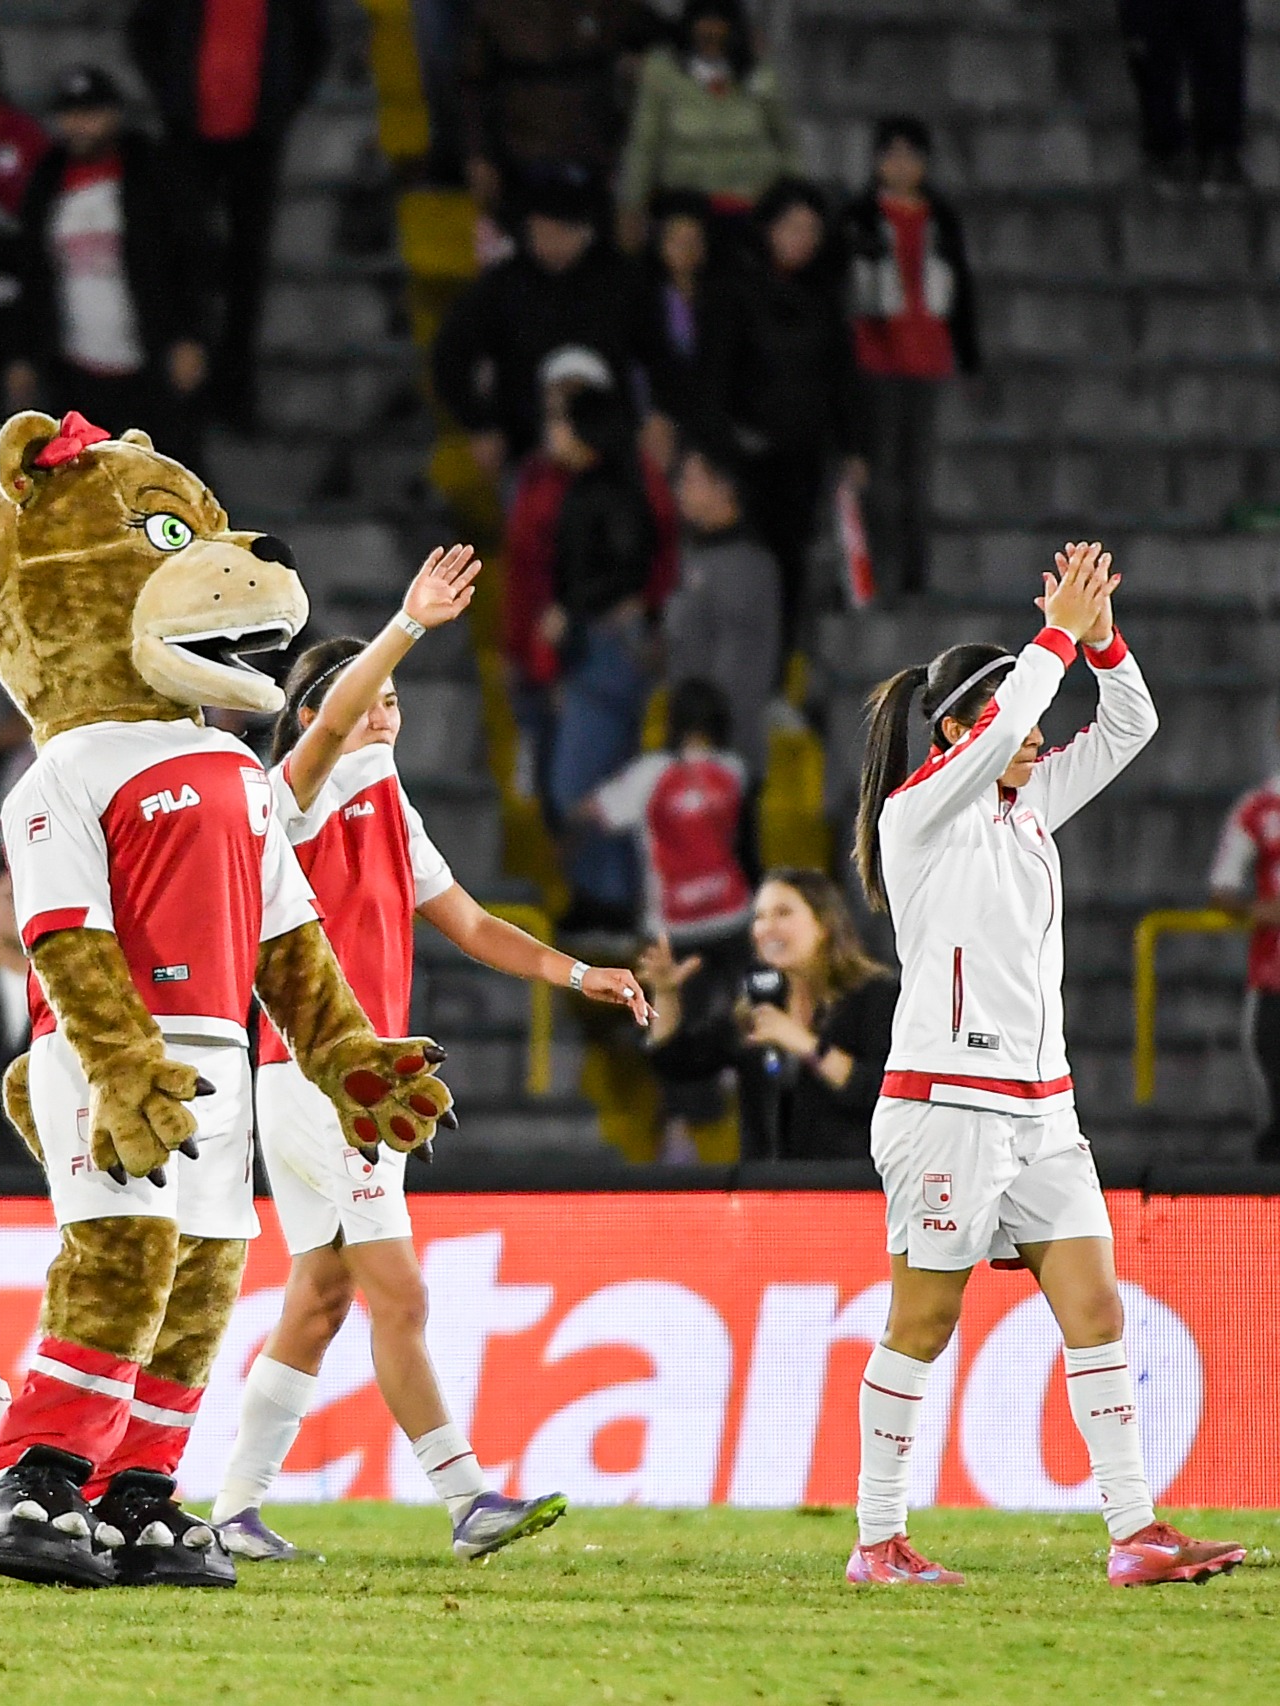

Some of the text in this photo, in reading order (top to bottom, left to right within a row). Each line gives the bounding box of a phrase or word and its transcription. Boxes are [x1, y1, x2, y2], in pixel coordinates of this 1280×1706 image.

[140, 784, 201, 822] FILA
[344, 800, 376, 821] FILA
[352, 1186, 385, 1202] FILA
[923, 1218, 957, 1231] FILA
[1091, 1405, 1136, 1417] SANT
